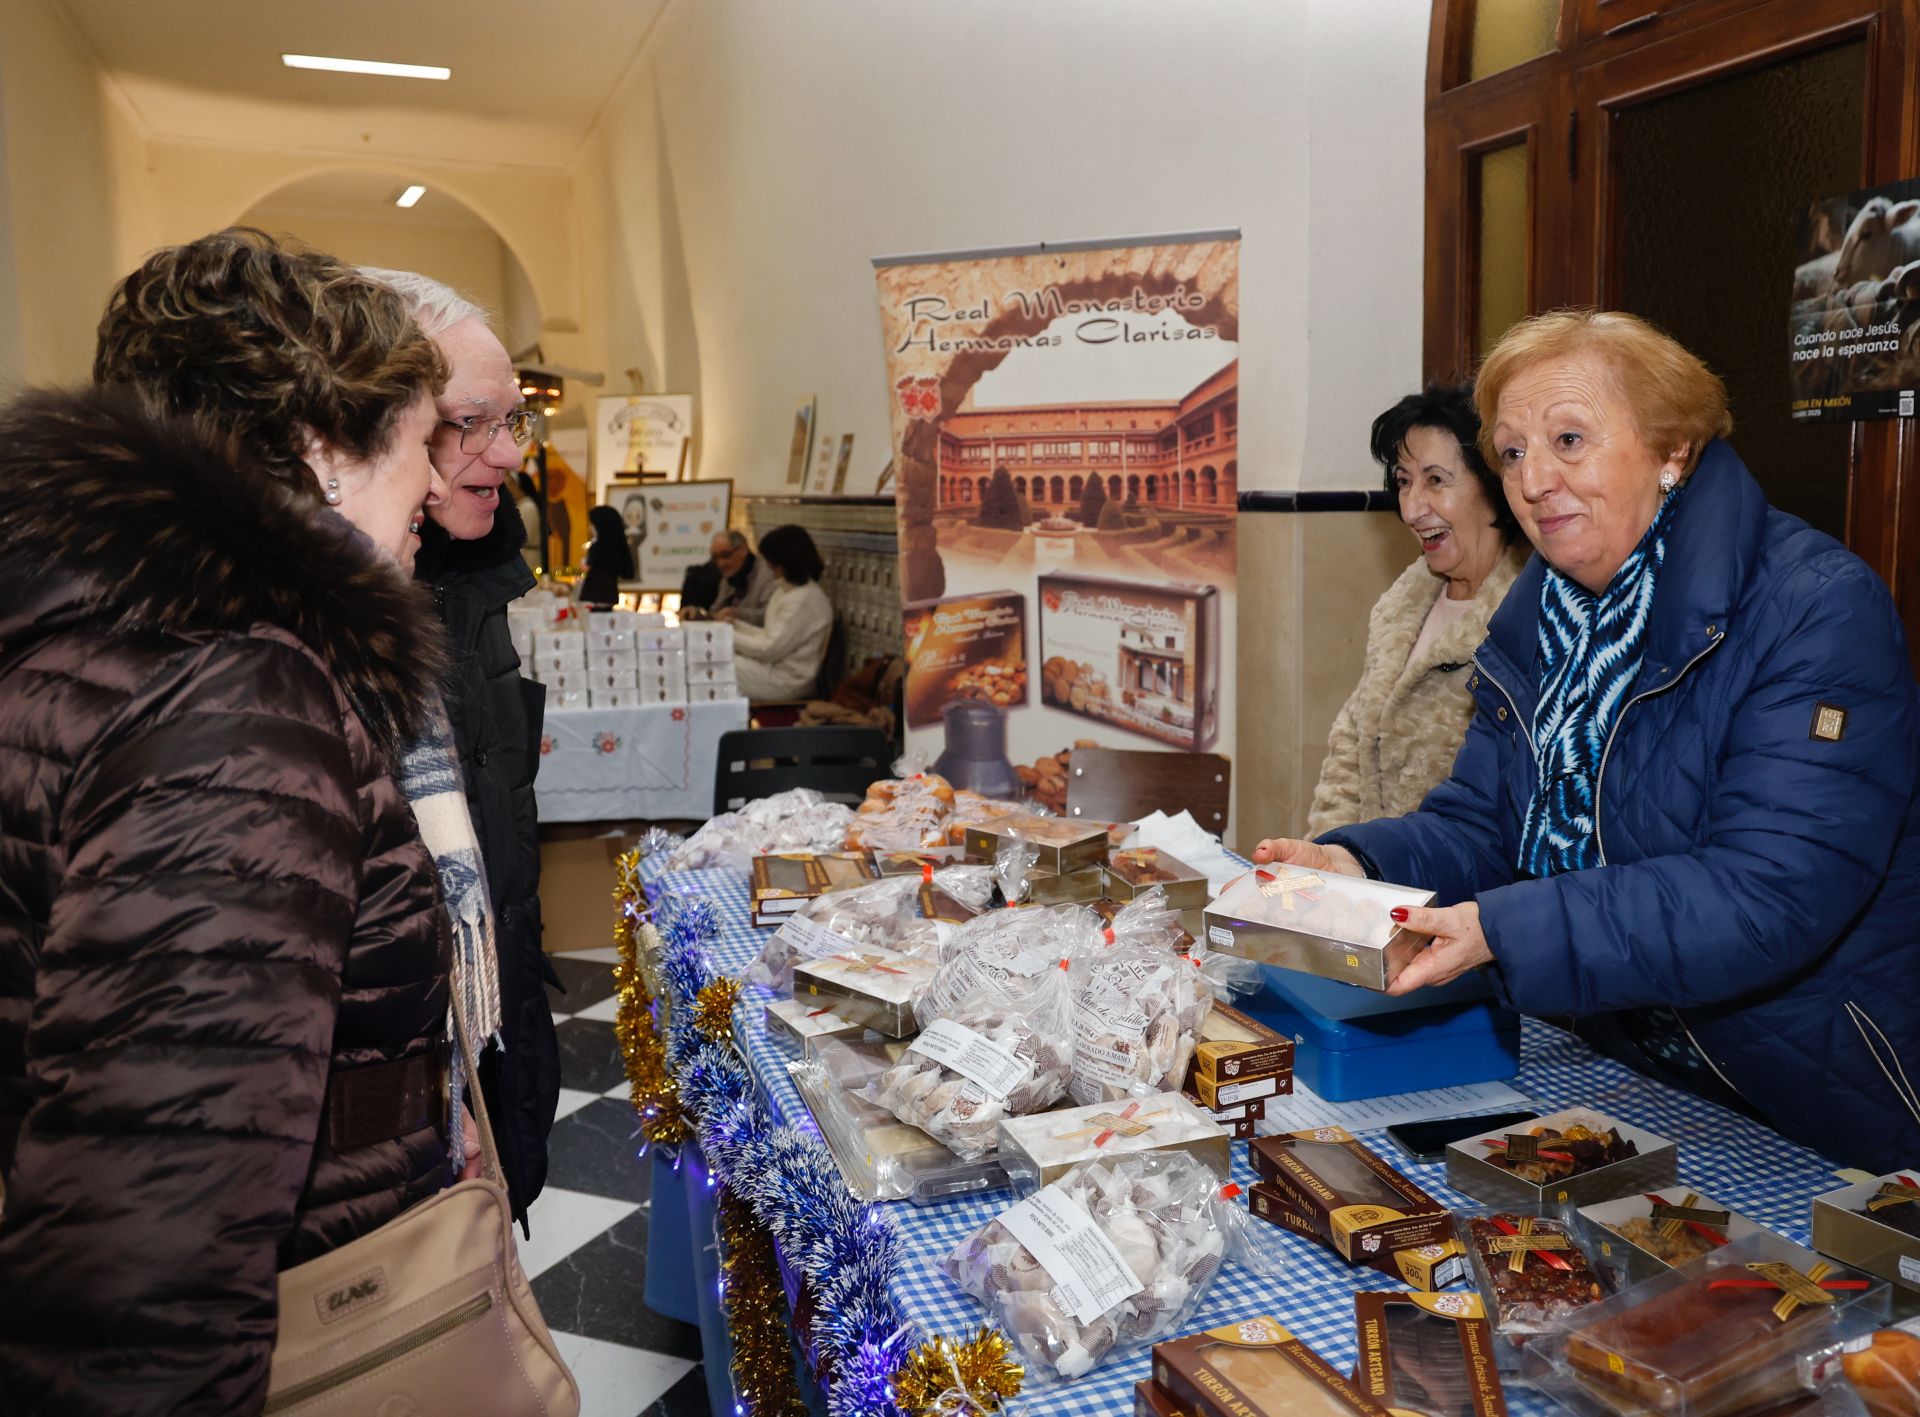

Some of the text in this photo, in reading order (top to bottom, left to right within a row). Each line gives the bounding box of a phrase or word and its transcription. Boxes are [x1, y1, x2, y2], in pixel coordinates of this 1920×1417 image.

[904, 287, 1205, 322] Real Monasterio
[897, 318, 1215, 353] Hermanas Clarisas
[1793, 340, 1899, 361] nace la esperanza
[1794, 321, 1901, 346] Cuando nace Jesús,
[1278, 1153, 1335, 1201] TURRÓN ARTESANO
[1405, 1267, 1423, 1283] 300g
[1365, 1319, 1384, 1350] TURRÓN
[1194, 1367, 1236, 1403] TURRÓN
[1368, 1352, 1386, 1396] ARTESANO
